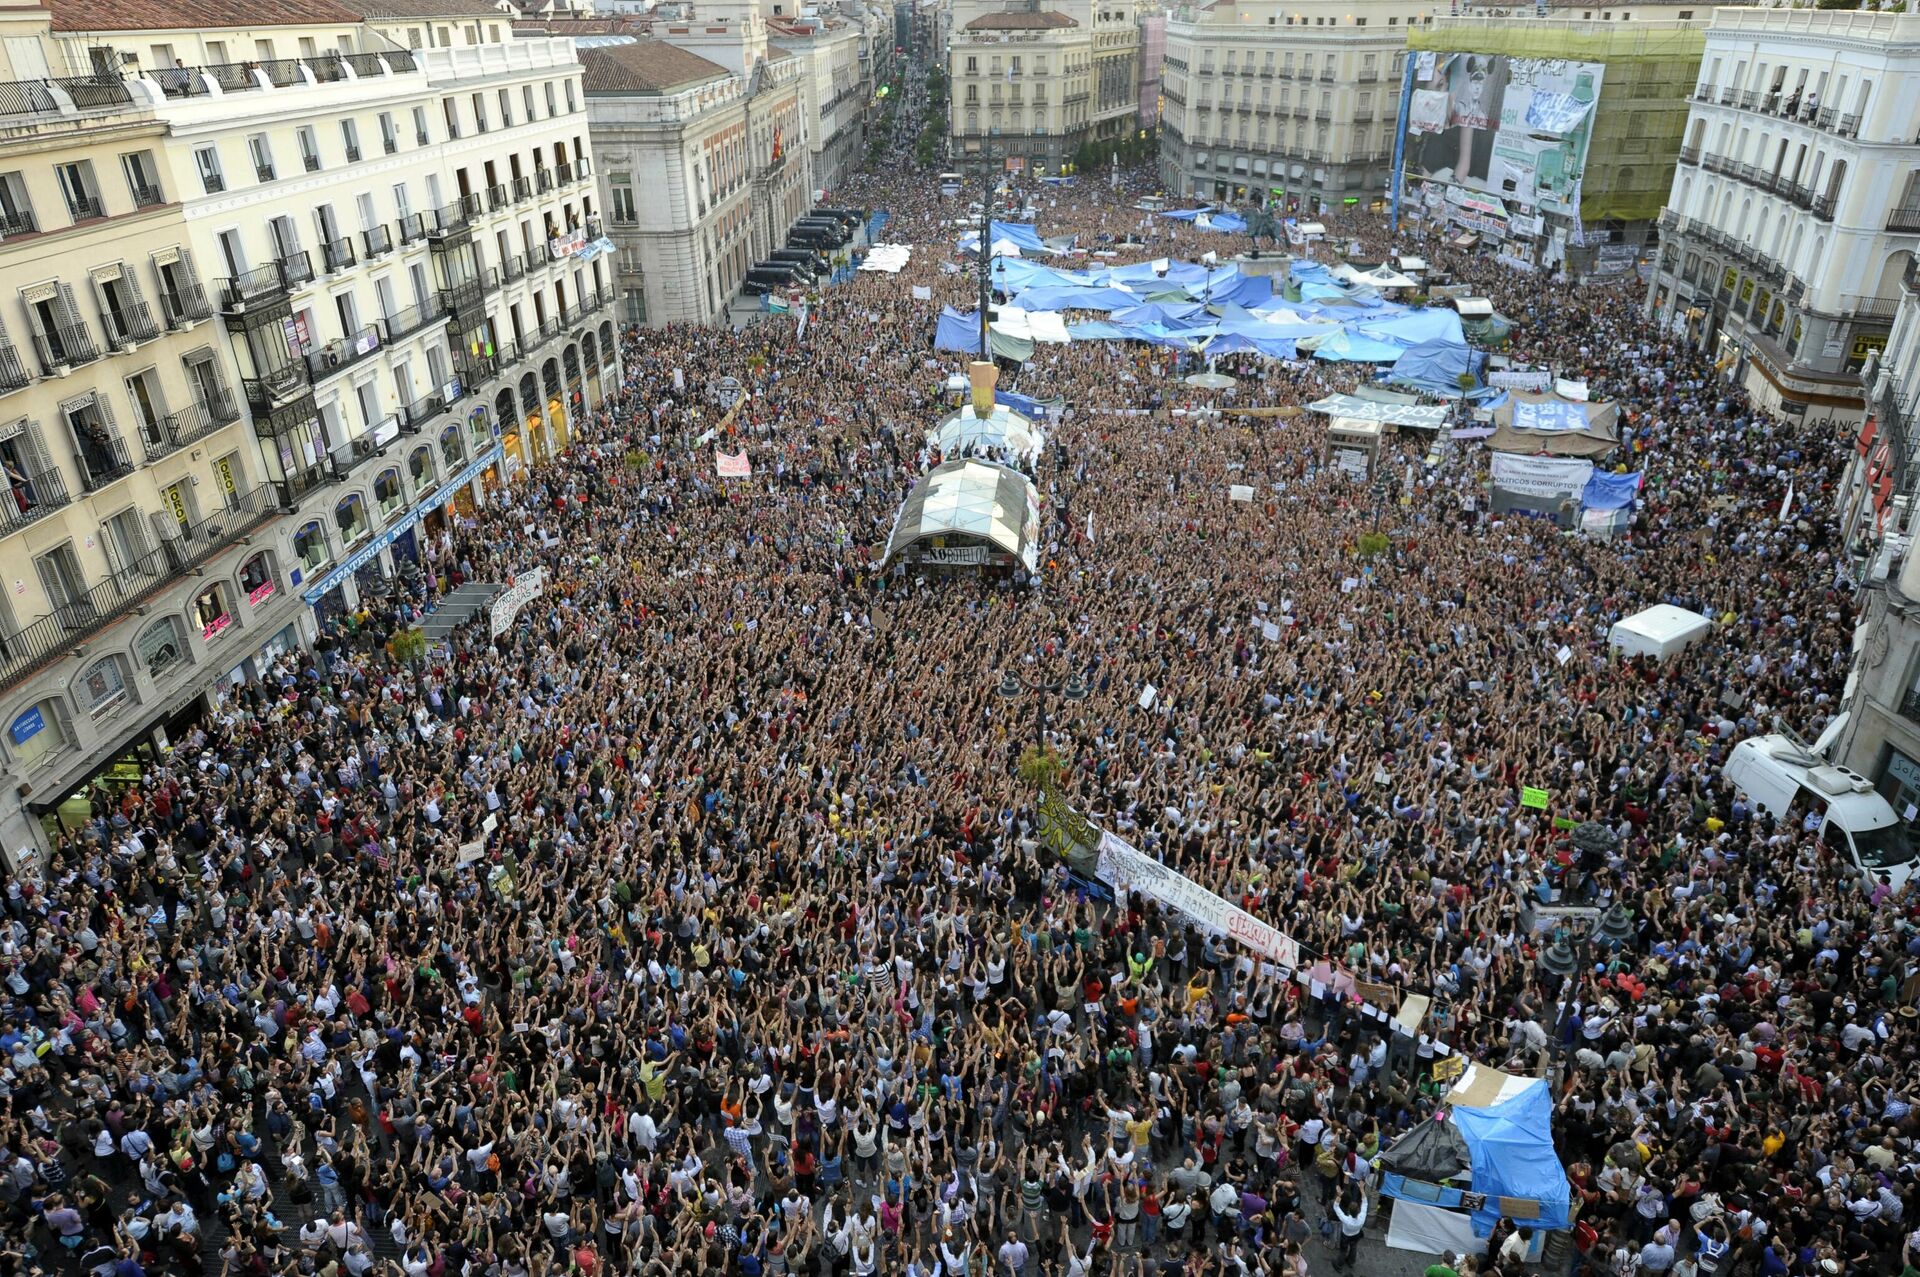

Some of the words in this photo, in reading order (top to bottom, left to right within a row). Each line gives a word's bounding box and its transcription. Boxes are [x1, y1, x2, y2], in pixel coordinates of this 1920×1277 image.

[1512, 71, 1538, 88] REAL
[96, 269, 119, 281] HOYOS
[220, 463, 234, 489] ORO
[1494, 476, 1530, 486] OLITICOS
[1531, 480, 1578, 490] CORRUPTOS
[170, 491, 184, 519] ORO
[320, 536, 389, 594] ZAPATERIAS
[434, 454, 495, 505] GUERRILLEROS
[929, 548, 947, 561] NO
